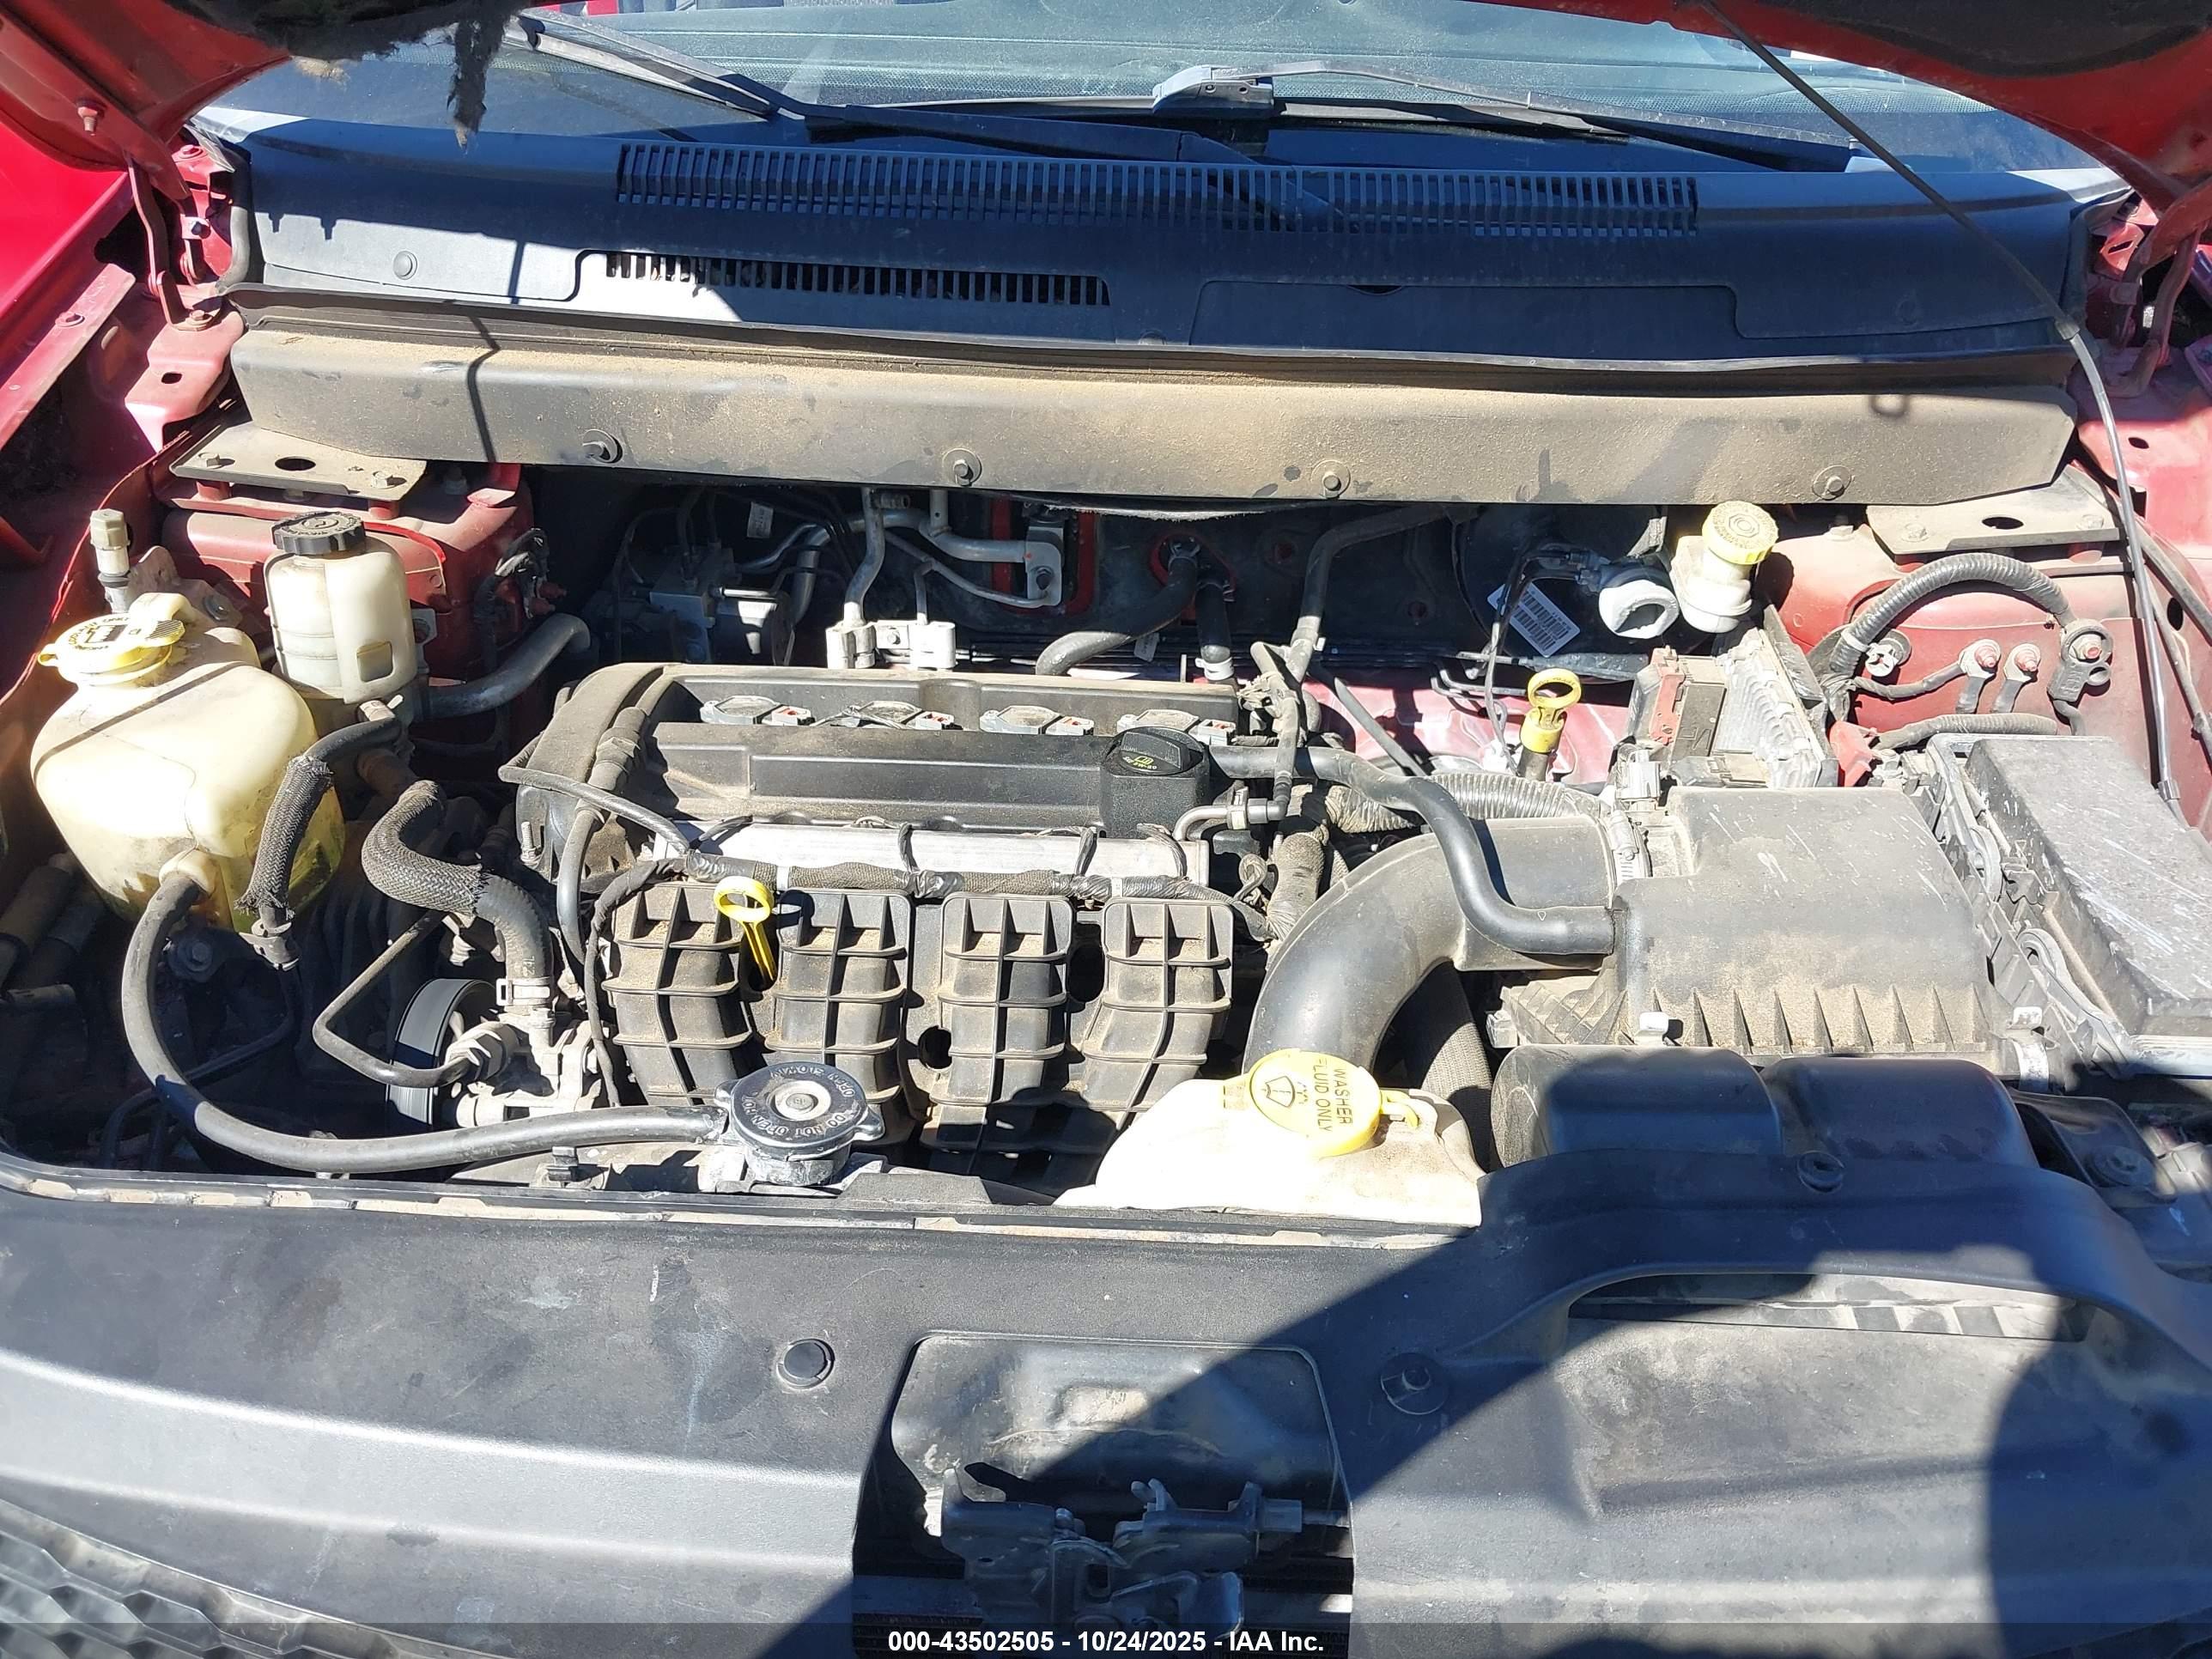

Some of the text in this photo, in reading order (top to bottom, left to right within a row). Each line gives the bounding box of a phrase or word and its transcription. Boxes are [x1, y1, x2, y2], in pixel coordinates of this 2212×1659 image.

[827, 1073, 856, 1097] OPEN
[1313, 1058, 1334, 1132] FLUID ONLY
[1333, 1068, 1353, 1125] WASHER
[750, 1115, 791, 1136] OPEN
[794, 1125, 826, 1138] NOT
[827, 1114, 847, 1127] DO
